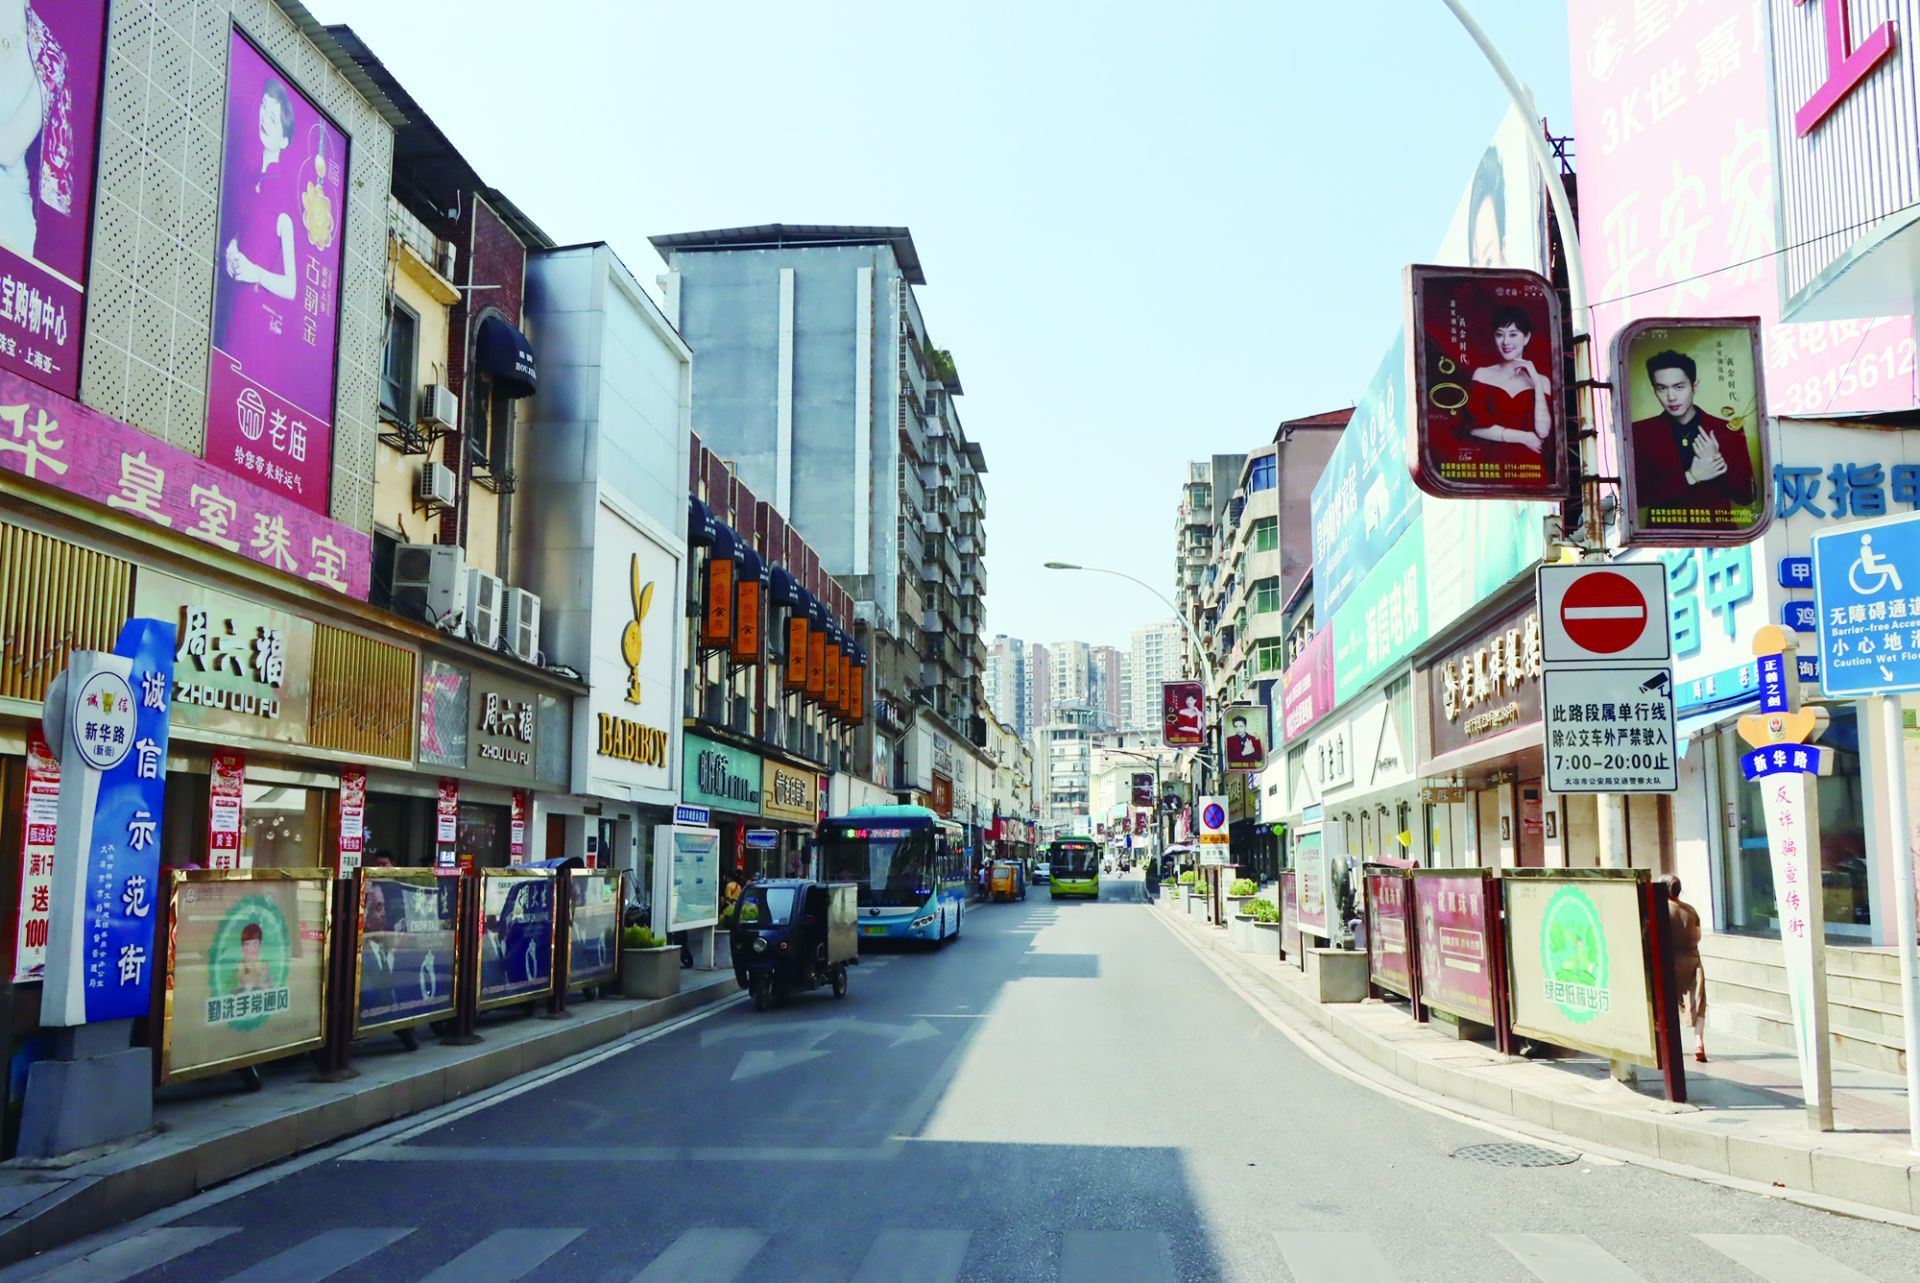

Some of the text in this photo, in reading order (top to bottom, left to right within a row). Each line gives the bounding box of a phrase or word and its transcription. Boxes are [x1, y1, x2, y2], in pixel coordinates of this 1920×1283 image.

[0, 273, 67, 346] 宝购物中心
[269, 408, 307, 462] 老庙
[234, 445, 302, 494] 给您带来好运气
[107, 452, 347, 593] 皇室珠宝
[176, 605, 287, 687] 周六福
[1831, 622, 1890, 637] Barrier-free
[1833, 657, 1872, 668] Caution
[1876, 653, 1897, 664] Wet
[176, 682, 281, 720] ZHOU LIU FU
[482, 692, 534, 744] 周六福
[1552, 702, 1667, 722] 此路段属单行线
[85, 721, 125, 745] 新华路
[597, 712, 670, 769] BABIBOY
[1552, 727, 1668, 748] 除公交车外严禁驶入
[481, 743, 530, 765] ZHOU LIU FU
[1753, 747, 1808, 772] 新华路
[1564, 777, 1661, 785] 大冶市公安局交通警察大队
[117, 671, 167, 986] 诚信示范街
[1775, 785, 1805, 938] 反诈骗宣传街
[32, 886, 49, 912] 送
[207, 988, 289, 1023] 勤洗手常通风
[1545, 980, 1610, 1011] 绿色低碳出行
